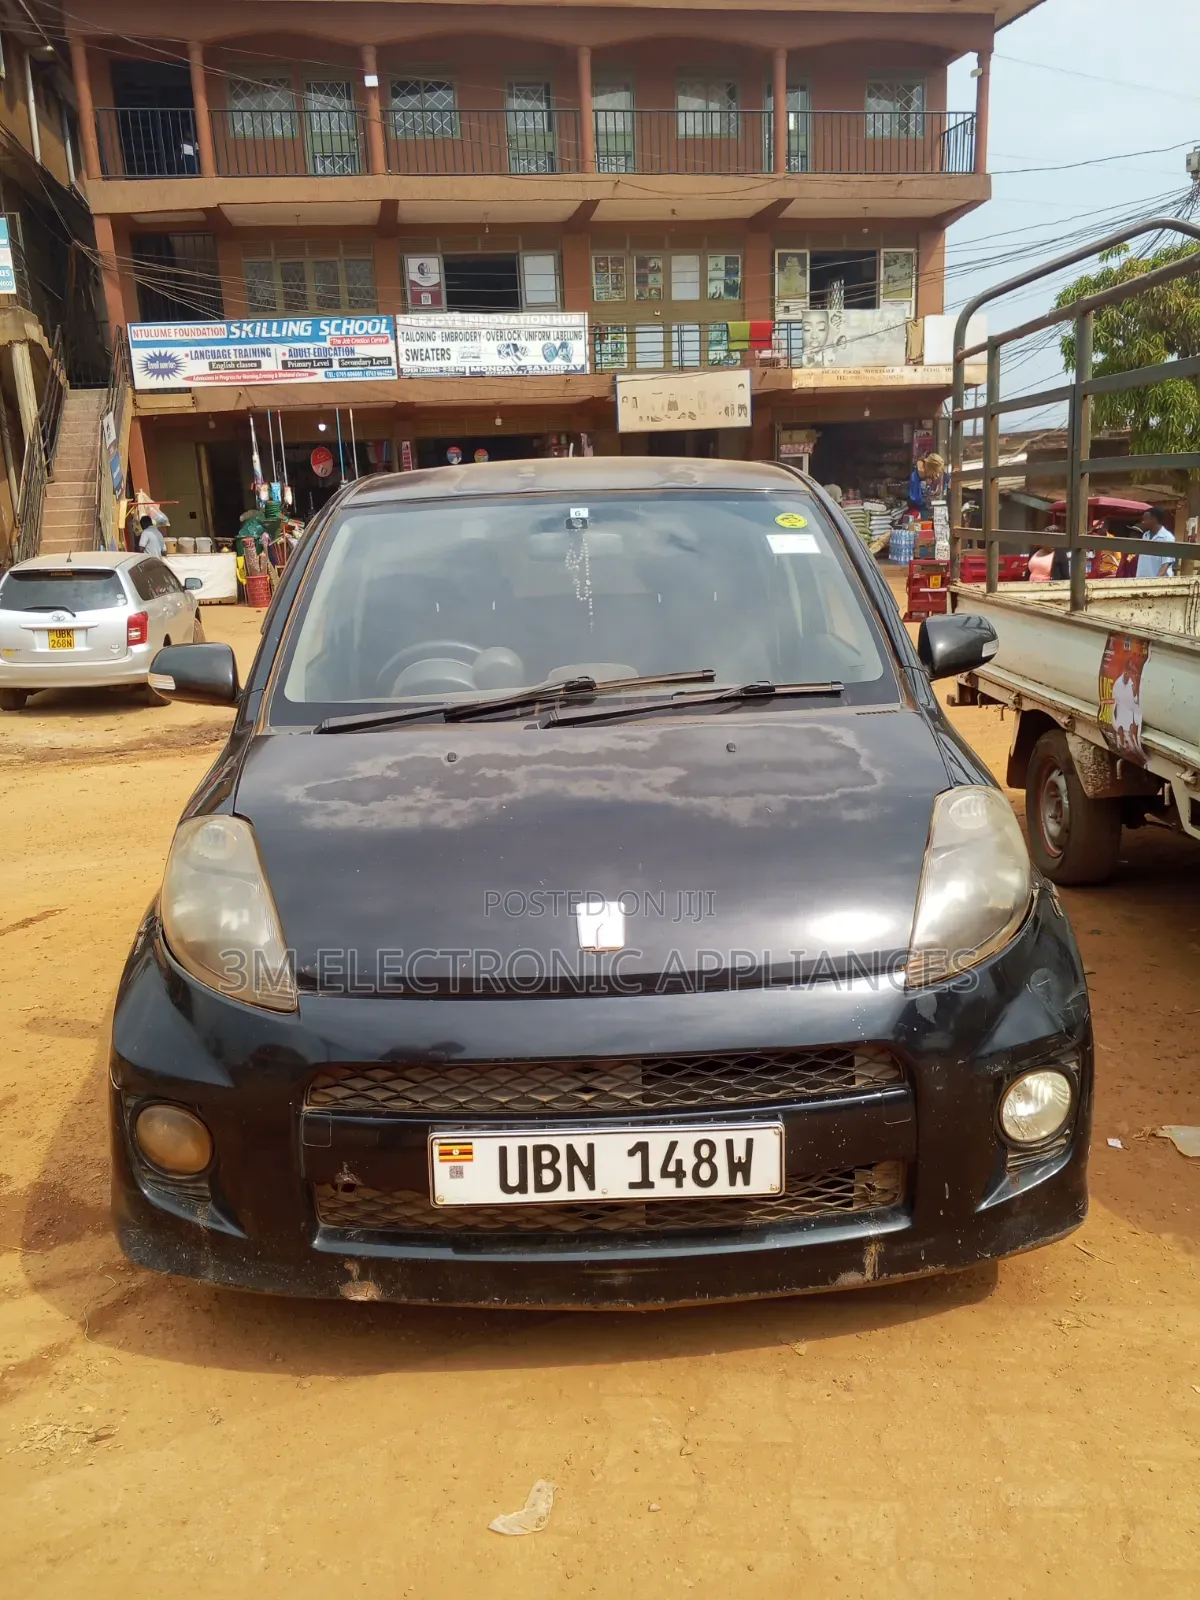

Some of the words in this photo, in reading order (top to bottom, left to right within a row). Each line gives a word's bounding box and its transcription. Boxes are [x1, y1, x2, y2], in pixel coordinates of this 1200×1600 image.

[133, 328, 172, 339] NTULUME
[175, 326, 226, 337] FOUNDATION
[228, 320, 312, 339] SKILLING
[318, 319, 390, 335] SCHOOL
[401, 331, 437, 342] TAILORING
[440, 331, 482, 342] EMBROIDERY
[486, 330, 522, 342] OVERLOCK
[525, 330, 551, 342] UNIFORM
[553, 330, 583, 341] LABELLING
[190, 348, 231, 360] LANGUAGE
[233, 347, 272, 359] TRAINING
[288, 347, 311, 358] ADULT
[313, 346, 356, 357] EDUCATION
[405, 348, 452, 362] SWEATERS
[212, 362, 235, 370] English
[287, 361, 312, 369] Primary
[341, 358, 371, 367] Secondary
[373, 357, 389, 365] Level
[471, 365, 518, 373] MONDAY
[55, 629, 72, 639] UBK
[51, 640, 73, 649] 268N
[498, 1142, 596, 1195] UBN
[627, 1137, 755, 1191] 148W
